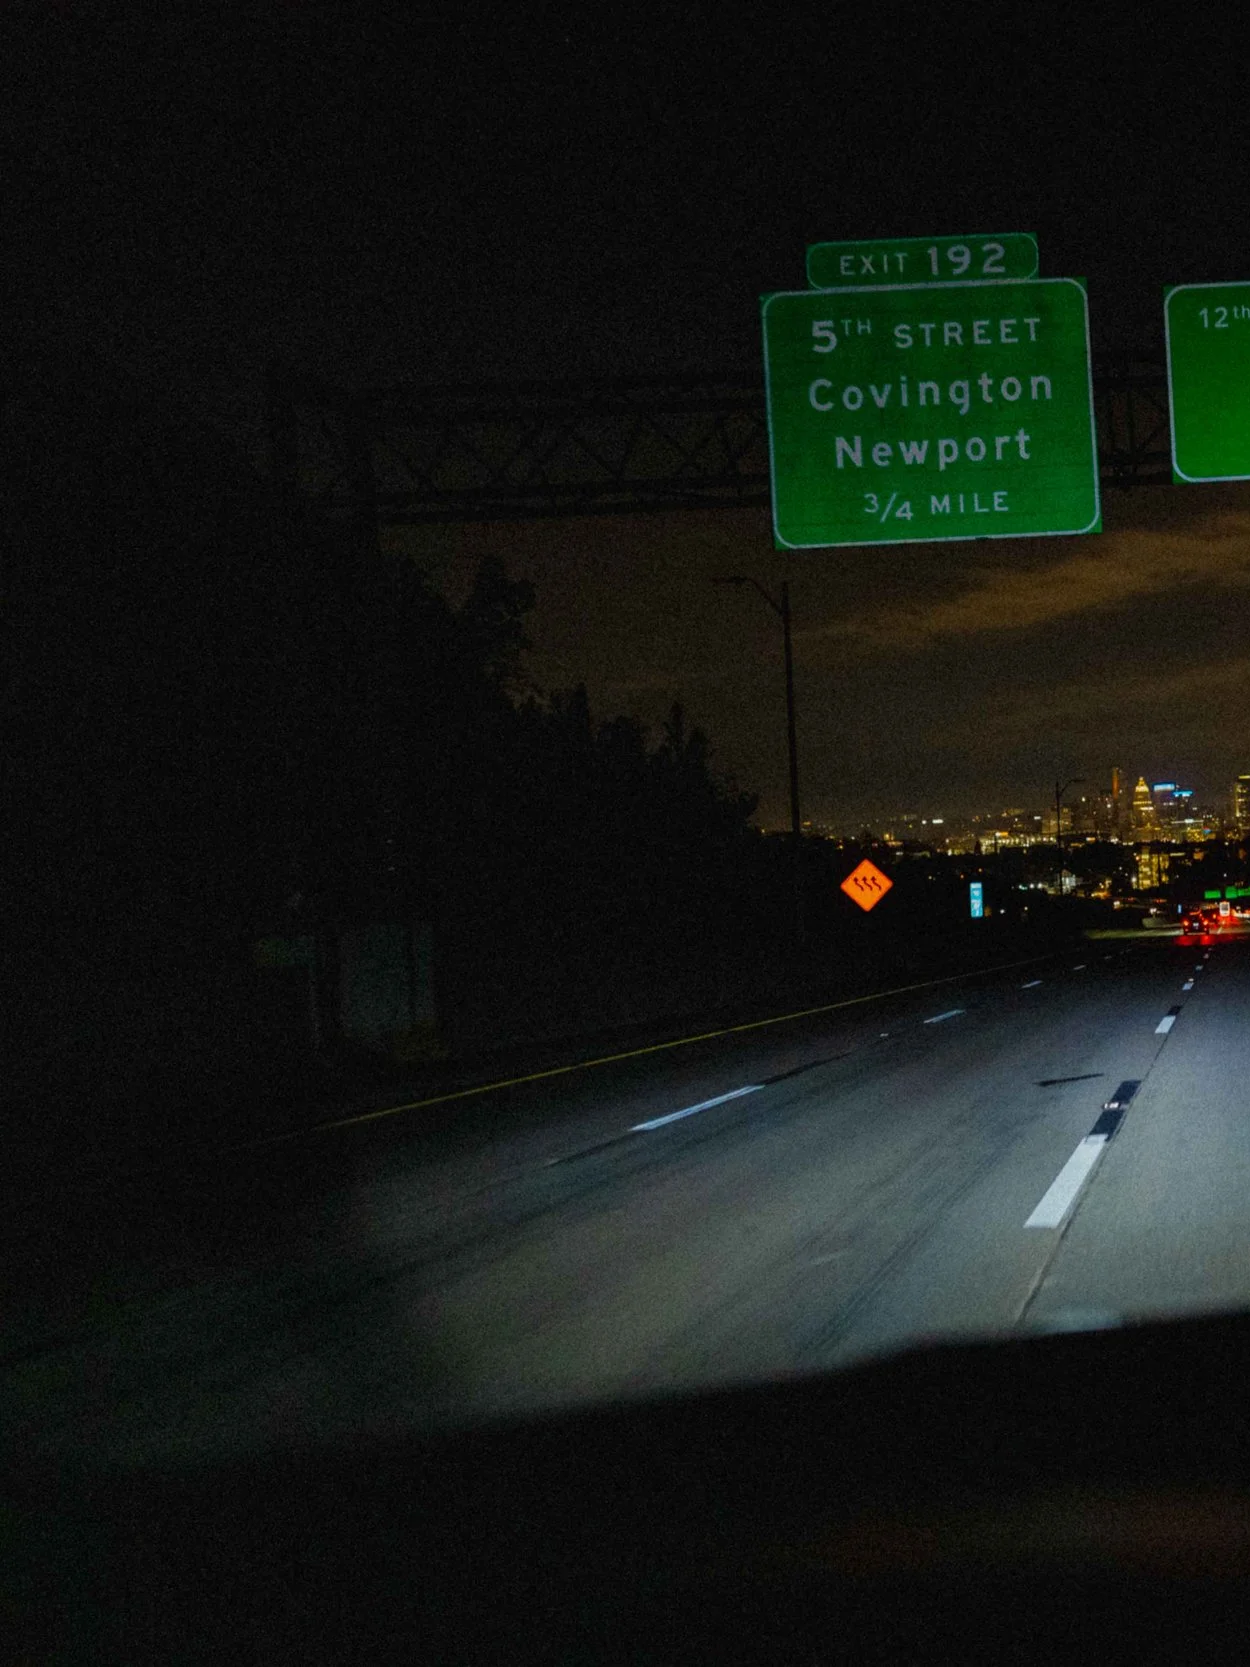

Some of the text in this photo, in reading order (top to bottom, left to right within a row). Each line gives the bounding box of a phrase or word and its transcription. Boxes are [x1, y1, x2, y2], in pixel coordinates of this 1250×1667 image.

[840, 243, 1006, 277] EXIT 192
[1199, 305, 1250, 328] 12th
[811, 318, 1040, 353] 5TH STREET
[809, 372, 1052, 415] Covington
[835, 428, 1031, 470] Newport
[864, 492, 1008, 523] 3/4 MILE
